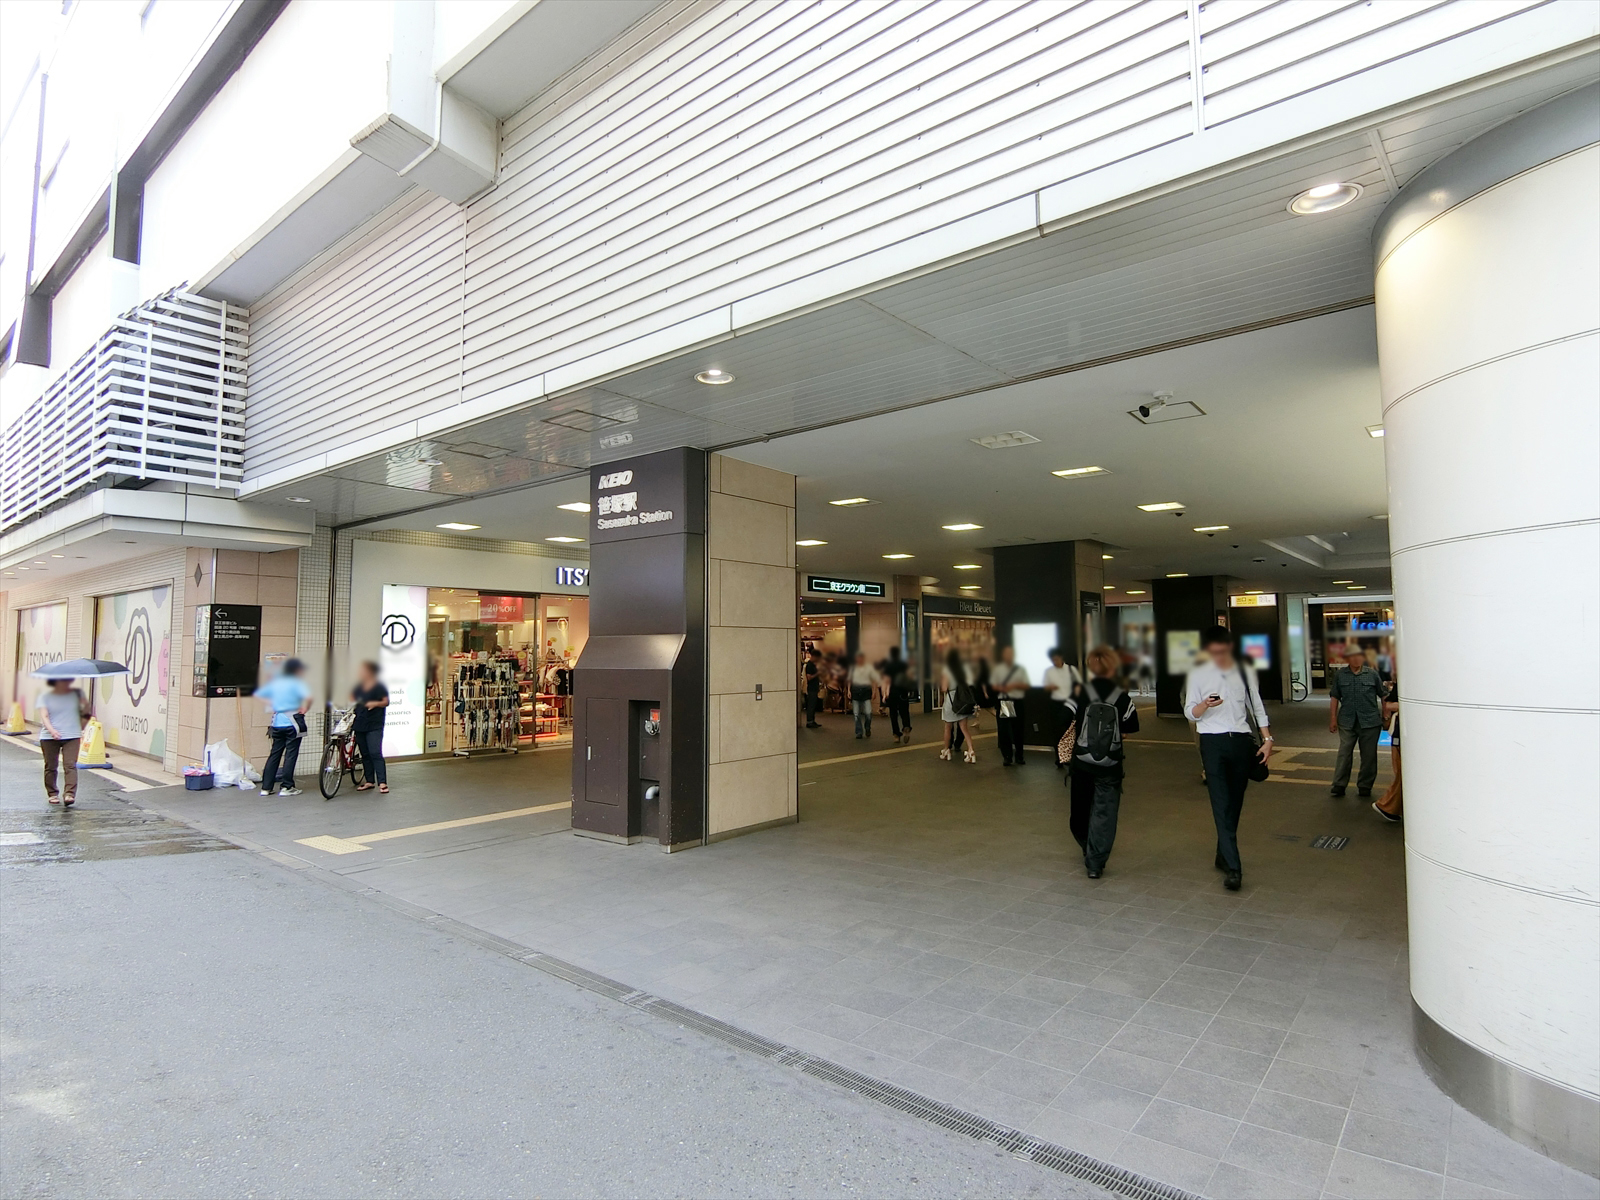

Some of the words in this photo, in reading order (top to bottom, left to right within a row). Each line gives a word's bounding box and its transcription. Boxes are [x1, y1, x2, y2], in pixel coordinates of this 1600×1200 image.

[598, 470, 633, 489] KEIO
[597, 515, 639, 530] Sasazuka
[639, 509, 673, 524] Station
[556, 566, 589, 586] ITS'
[121, 714, 149, 735] ITS'DEMO
